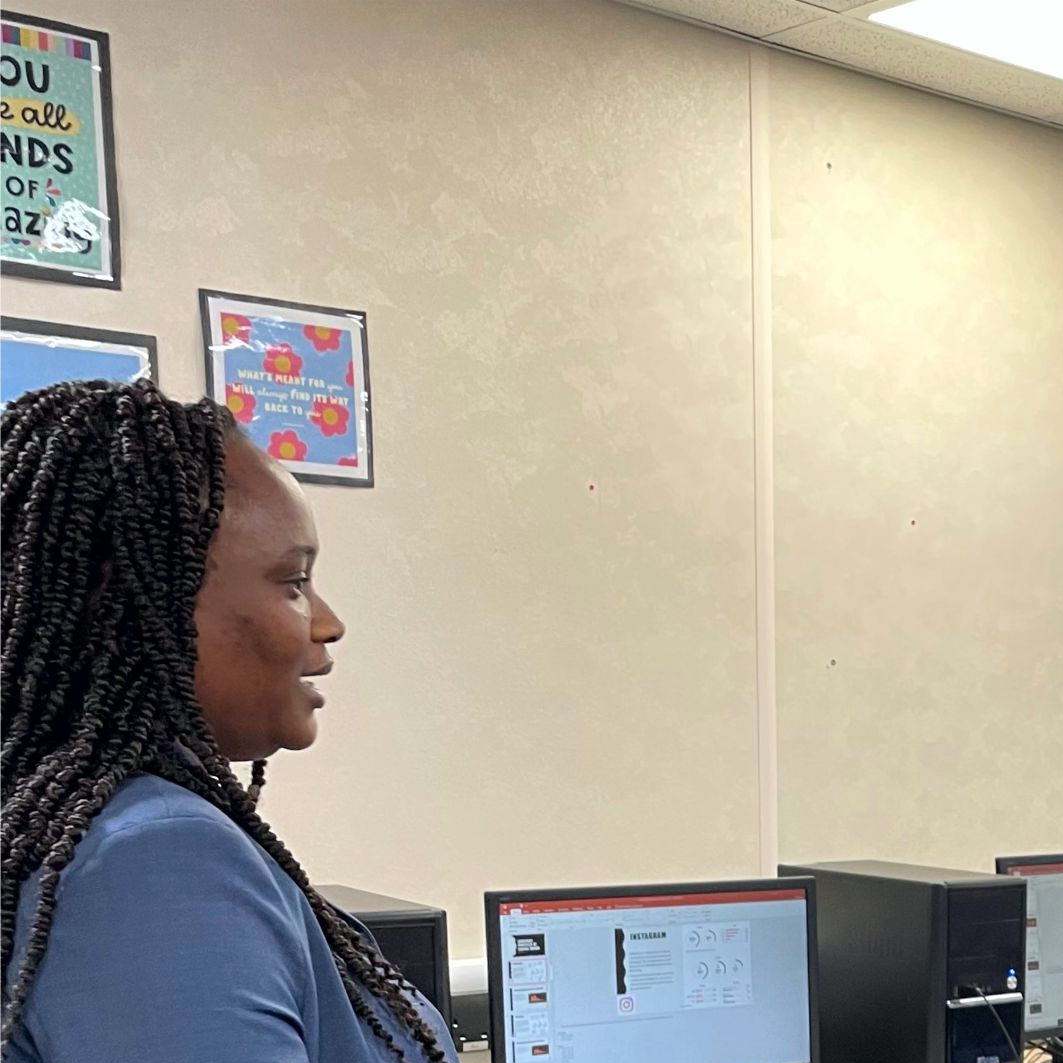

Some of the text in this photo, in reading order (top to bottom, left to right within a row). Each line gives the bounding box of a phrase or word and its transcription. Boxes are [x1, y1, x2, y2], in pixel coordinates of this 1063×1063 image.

[21, 102, 72, 131] all
[6, 176, 39, 199] OF
[237, 368, 272, 382] WHAT'S
[275, 374, 305, 386] MEANT
[309, 378, 325, 389] FOR
[231, 383, 255, 395] WILL
[290, 389, 310, 401] FIND
[313, 394, 329, 404] ITS
[330, 395, 349, 406] WAY
[265, 402, 288, 413] BACK
[291, 406, 303, 415] TO
[630, 931, 667, 941] INSTAGRAM
